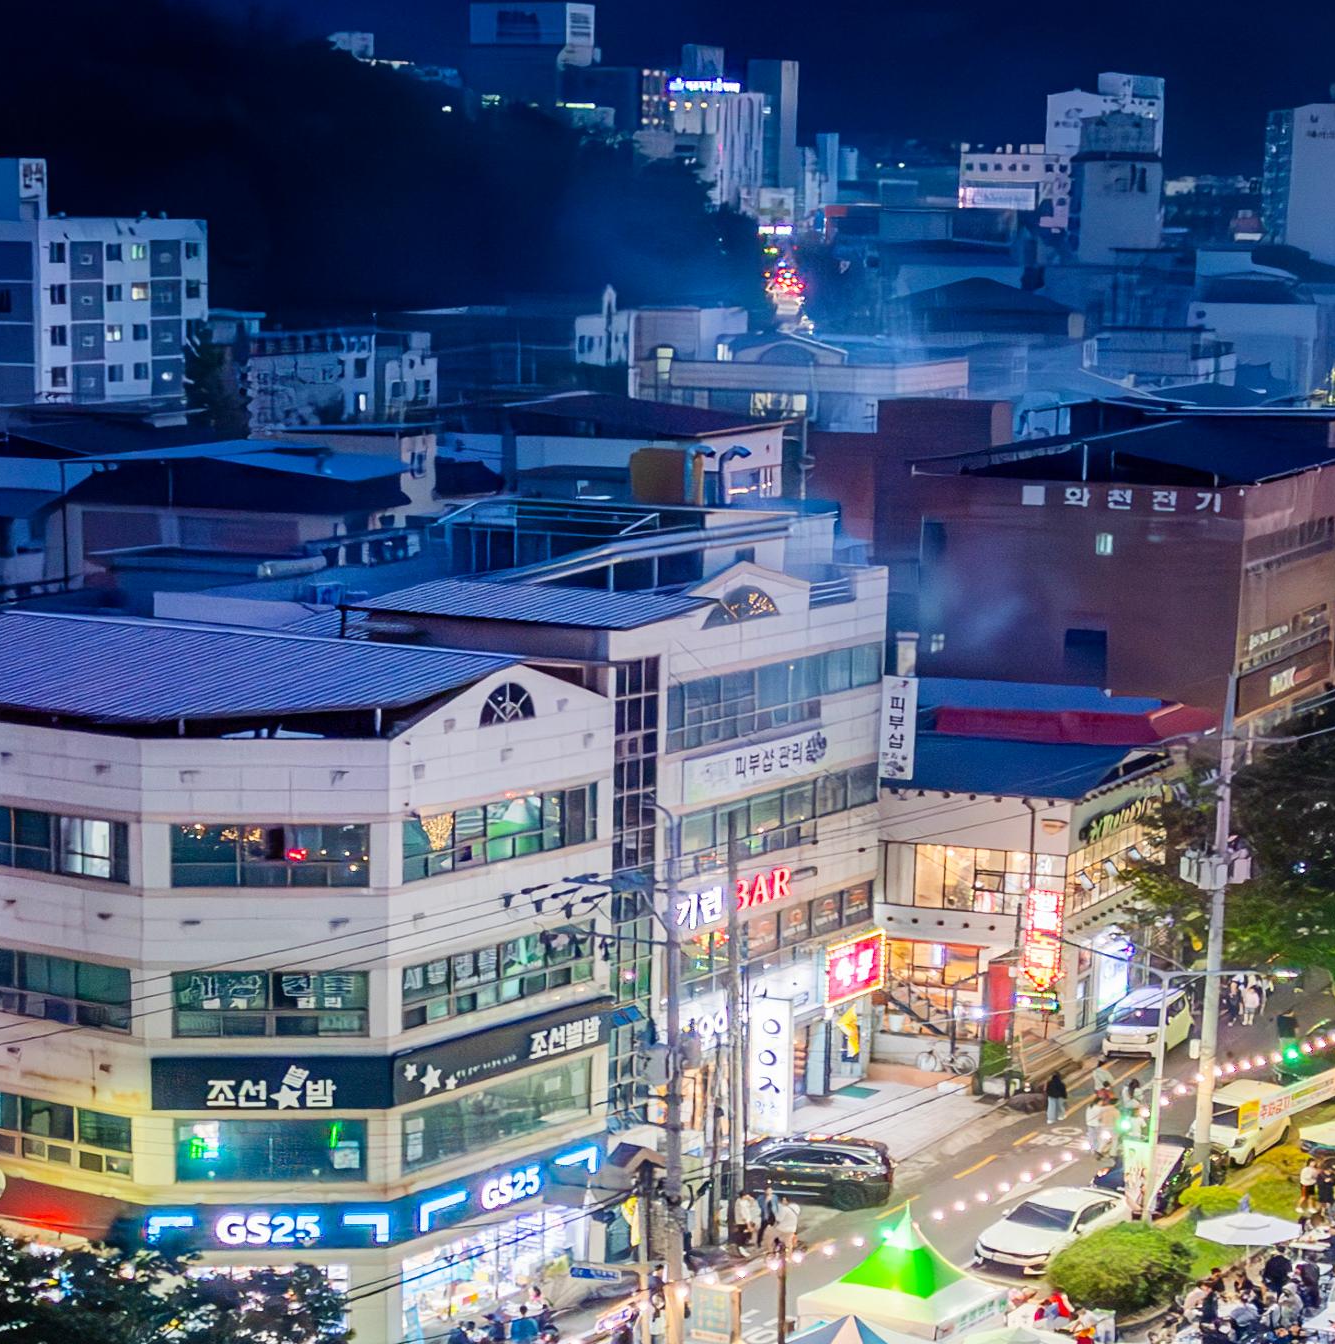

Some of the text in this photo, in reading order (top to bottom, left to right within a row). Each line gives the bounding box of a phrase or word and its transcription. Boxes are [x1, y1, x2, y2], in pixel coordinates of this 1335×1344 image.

[675, 865, 792, 930] 기린 BAR
[528, 1015, 602, 1060] 조선별밤
[205, 1064, 337, 1109] 조선별밤
[480, 1166, 541, 1210] GS25
[214, 1213, 322, 1246] GS25
